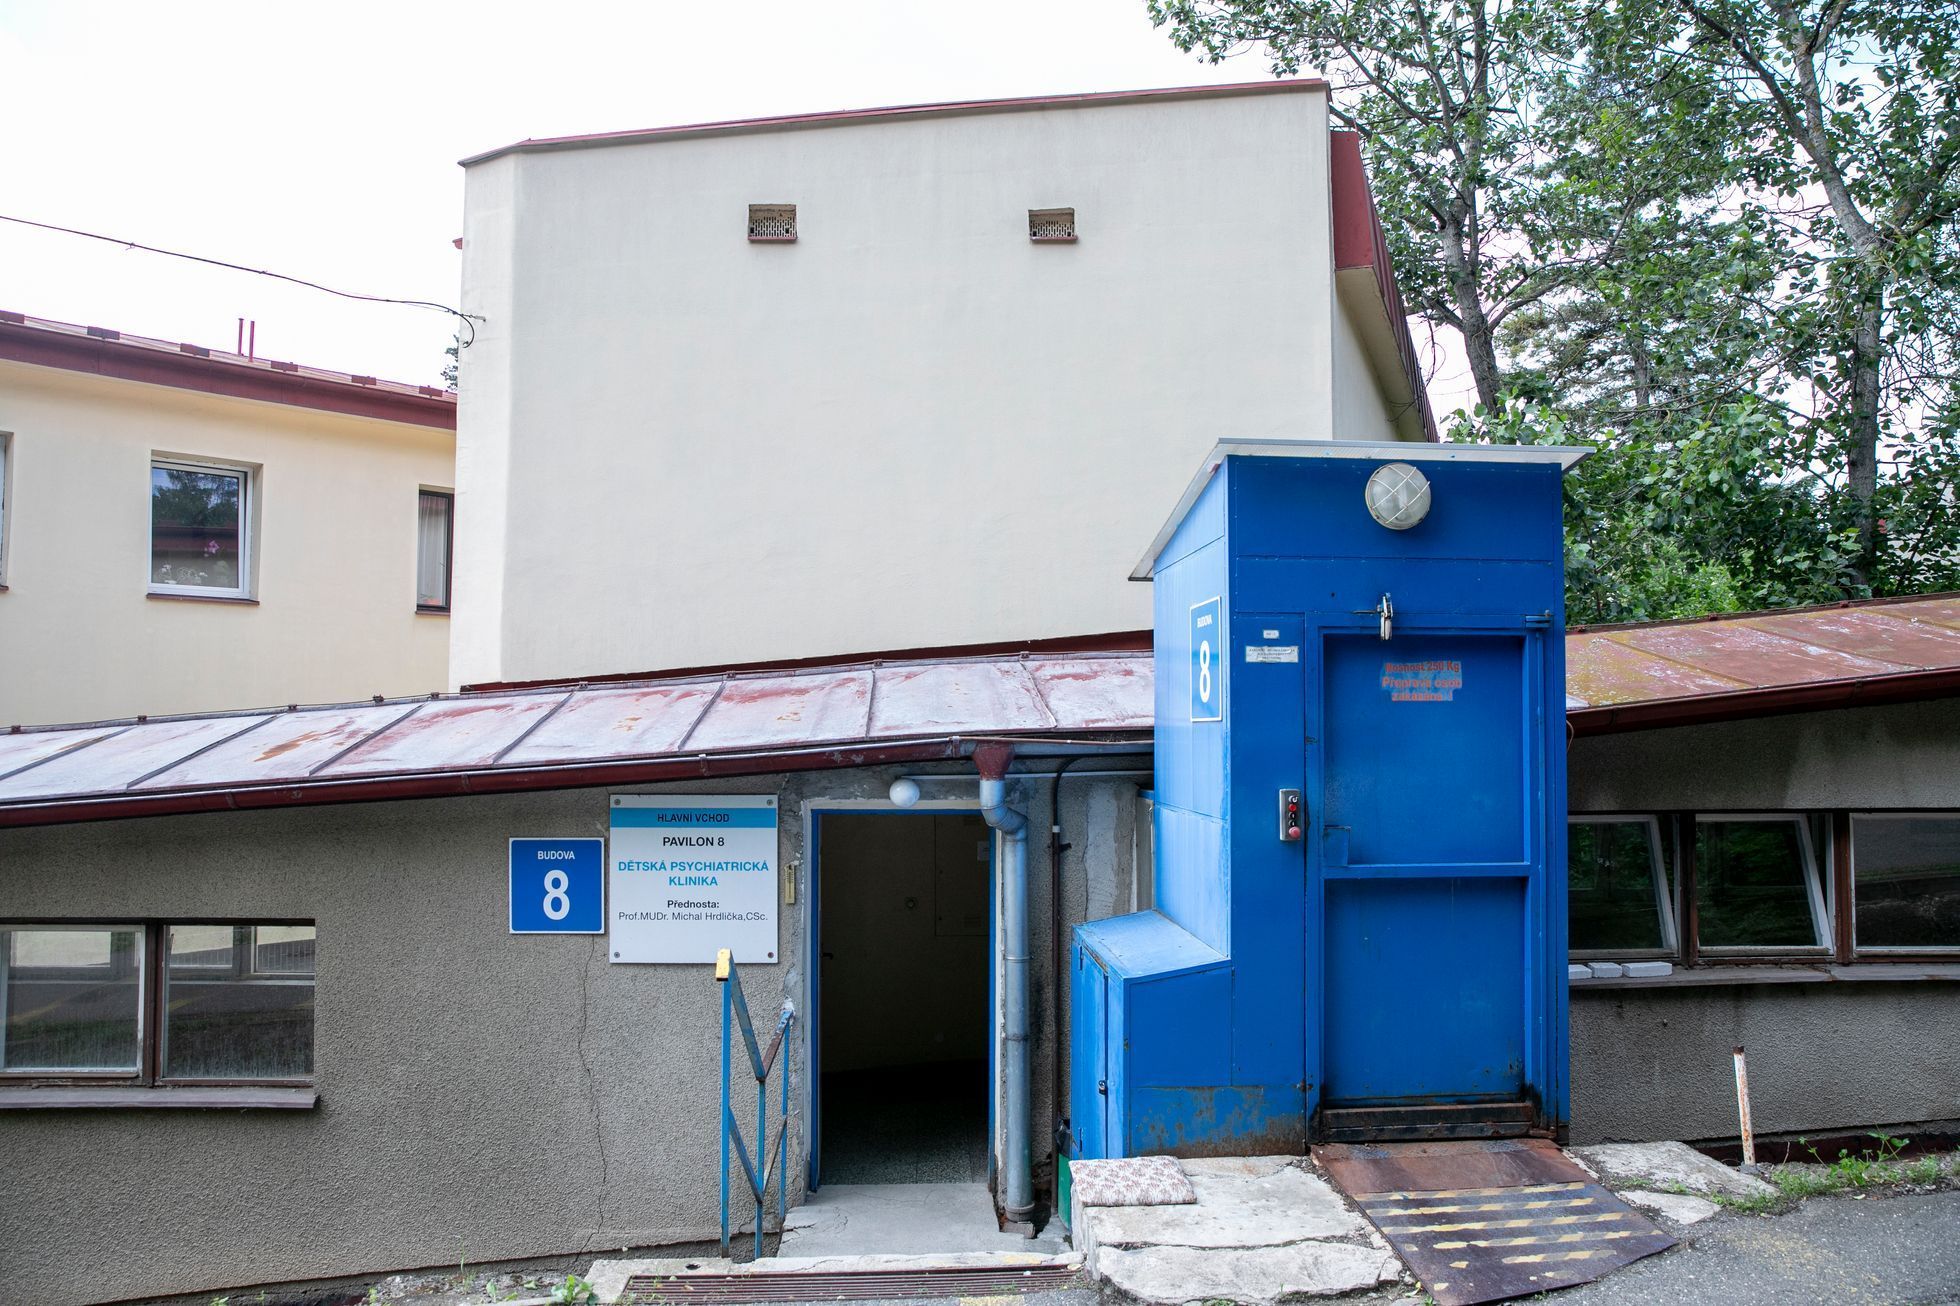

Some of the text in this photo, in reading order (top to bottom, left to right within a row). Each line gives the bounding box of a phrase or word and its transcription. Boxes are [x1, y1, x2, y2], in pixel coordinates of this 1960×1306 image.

[1426, 660, 1444, 672] 250
[1199, 640, 1211, 704] 8
[657, 812, 730, 823] HLAVNÍ VCHOD
[662, 836, 725, 847] PAVILON 8
[537, 850, 576, 860] BUDOVA
[618, 860, 769, 872] DĚTSKÁ PSYCHIATRICKÁ
[668, 876, 718, 886] KLINIKA
[543, 869, 571, 921] 8
[667, 900, 720, 909] Přednosta:
[618, 911, 768, 922] Prof.MUDr. Michal Hrdlička,CSc.
